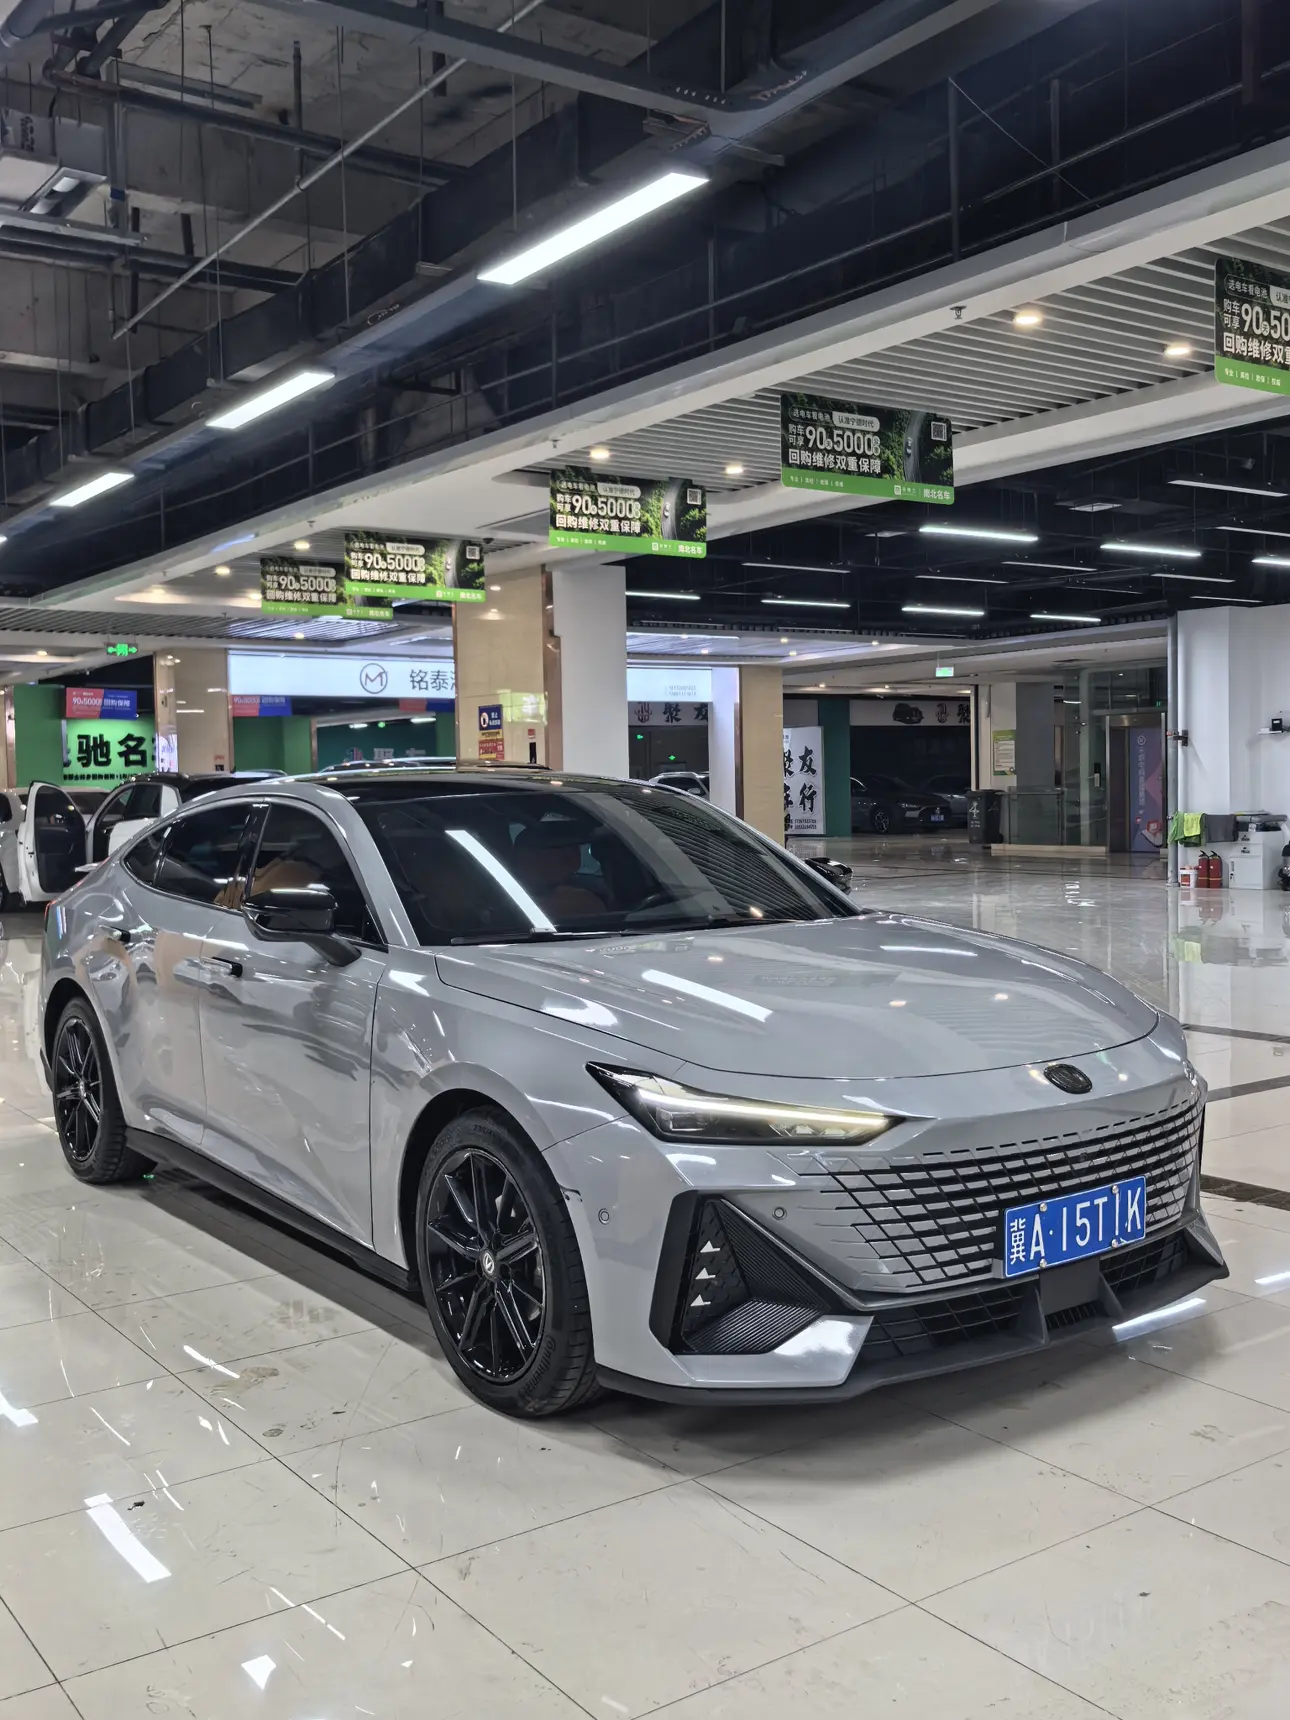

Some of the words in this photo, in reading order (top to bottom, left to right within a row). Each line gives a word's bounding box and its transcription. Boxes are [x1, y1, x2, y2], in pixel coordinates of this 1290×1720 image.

[1223, 298, 1240, 313] 购车
[788, 423, 804, 435] 购车
[788, 448, 881, 474] 回购维修双重保障
[555, 514, 641, 534] 回购维修双重保障
[350, 569, 425, 584] 回购维修双重保障
[266, 590, 336, 603] 回购维修双重保障
[410, 669, 455, 691] 铭泰
[63, 733, 156, 768] 驰名
